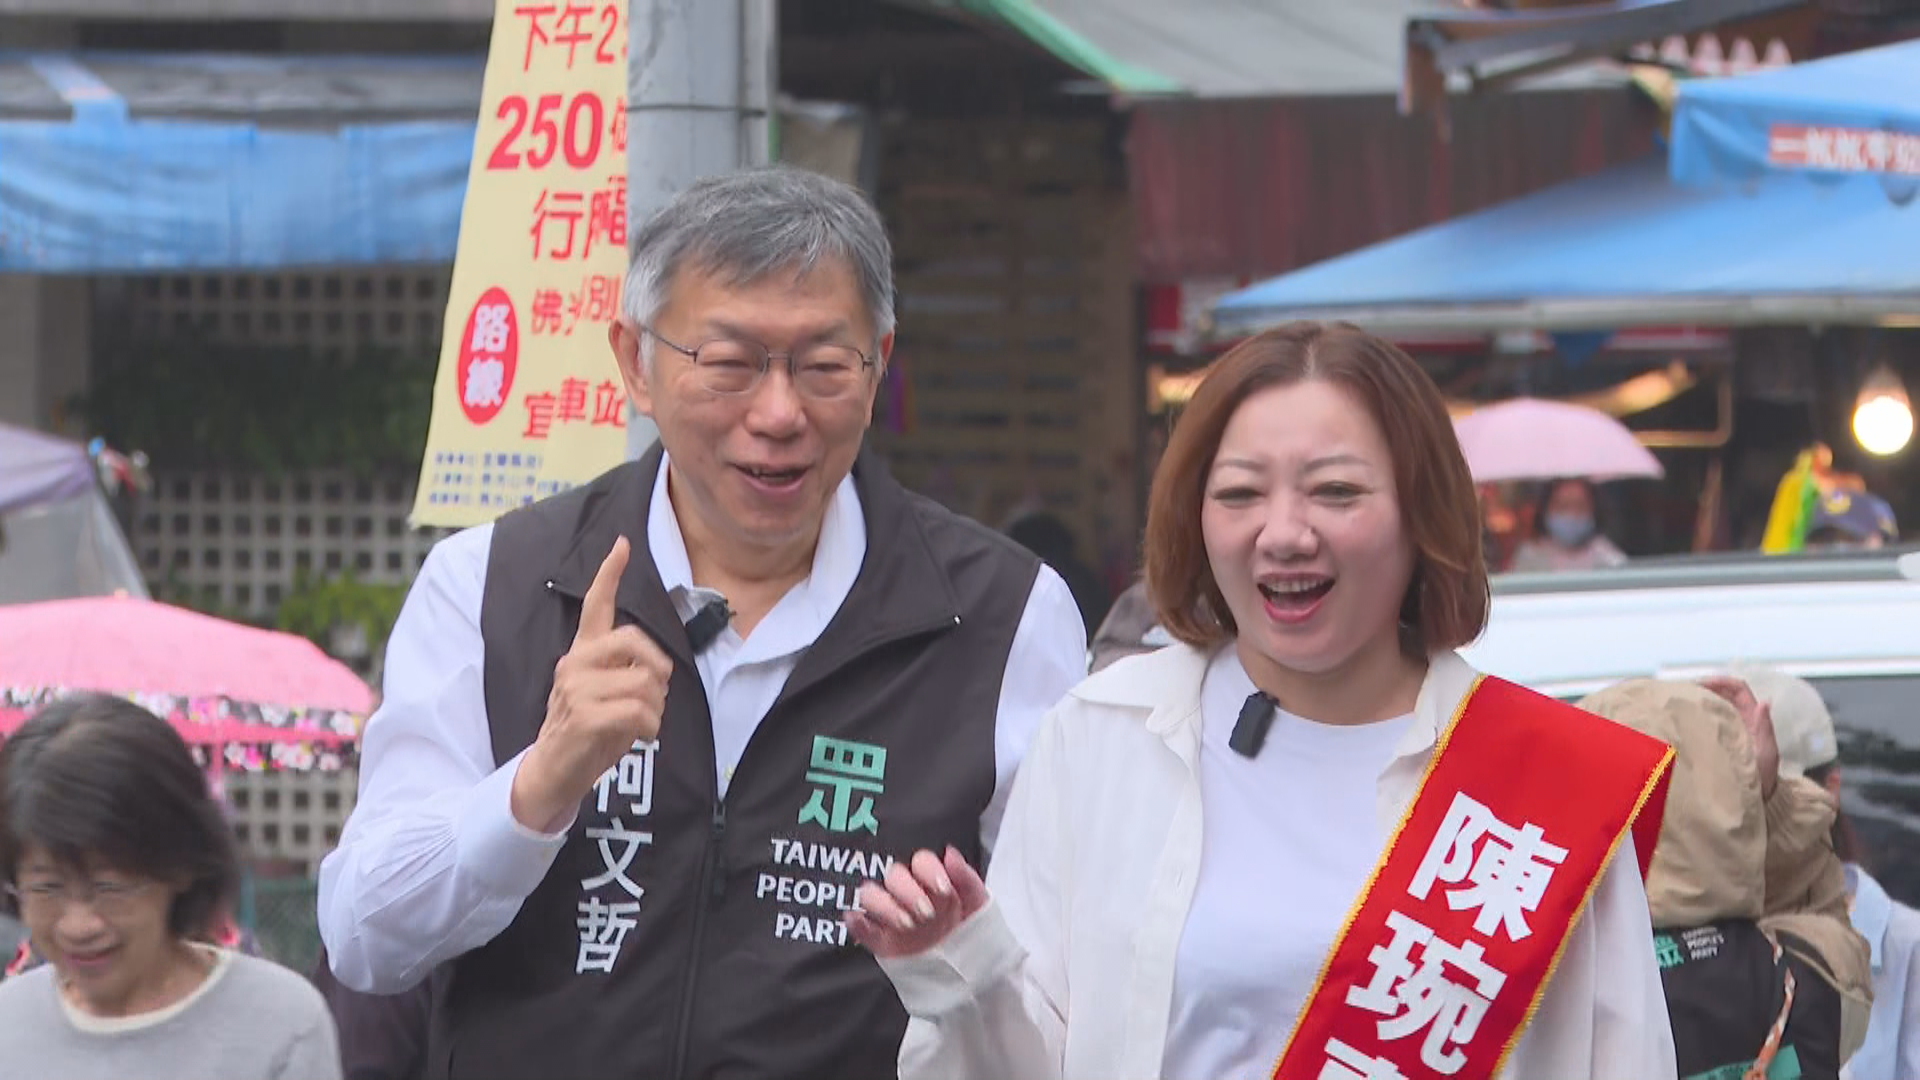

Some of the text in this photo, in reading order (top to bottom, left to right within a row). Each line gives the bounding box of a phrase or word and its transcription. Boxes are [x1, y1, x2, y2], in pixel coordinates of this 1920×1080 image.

[514, 2, 627, 72] 下午2
[798, 735, 887, 836] 眾
[576, 738, 660, 974] 柯文哲
[771, 838, 894, 879] TAIWAN
